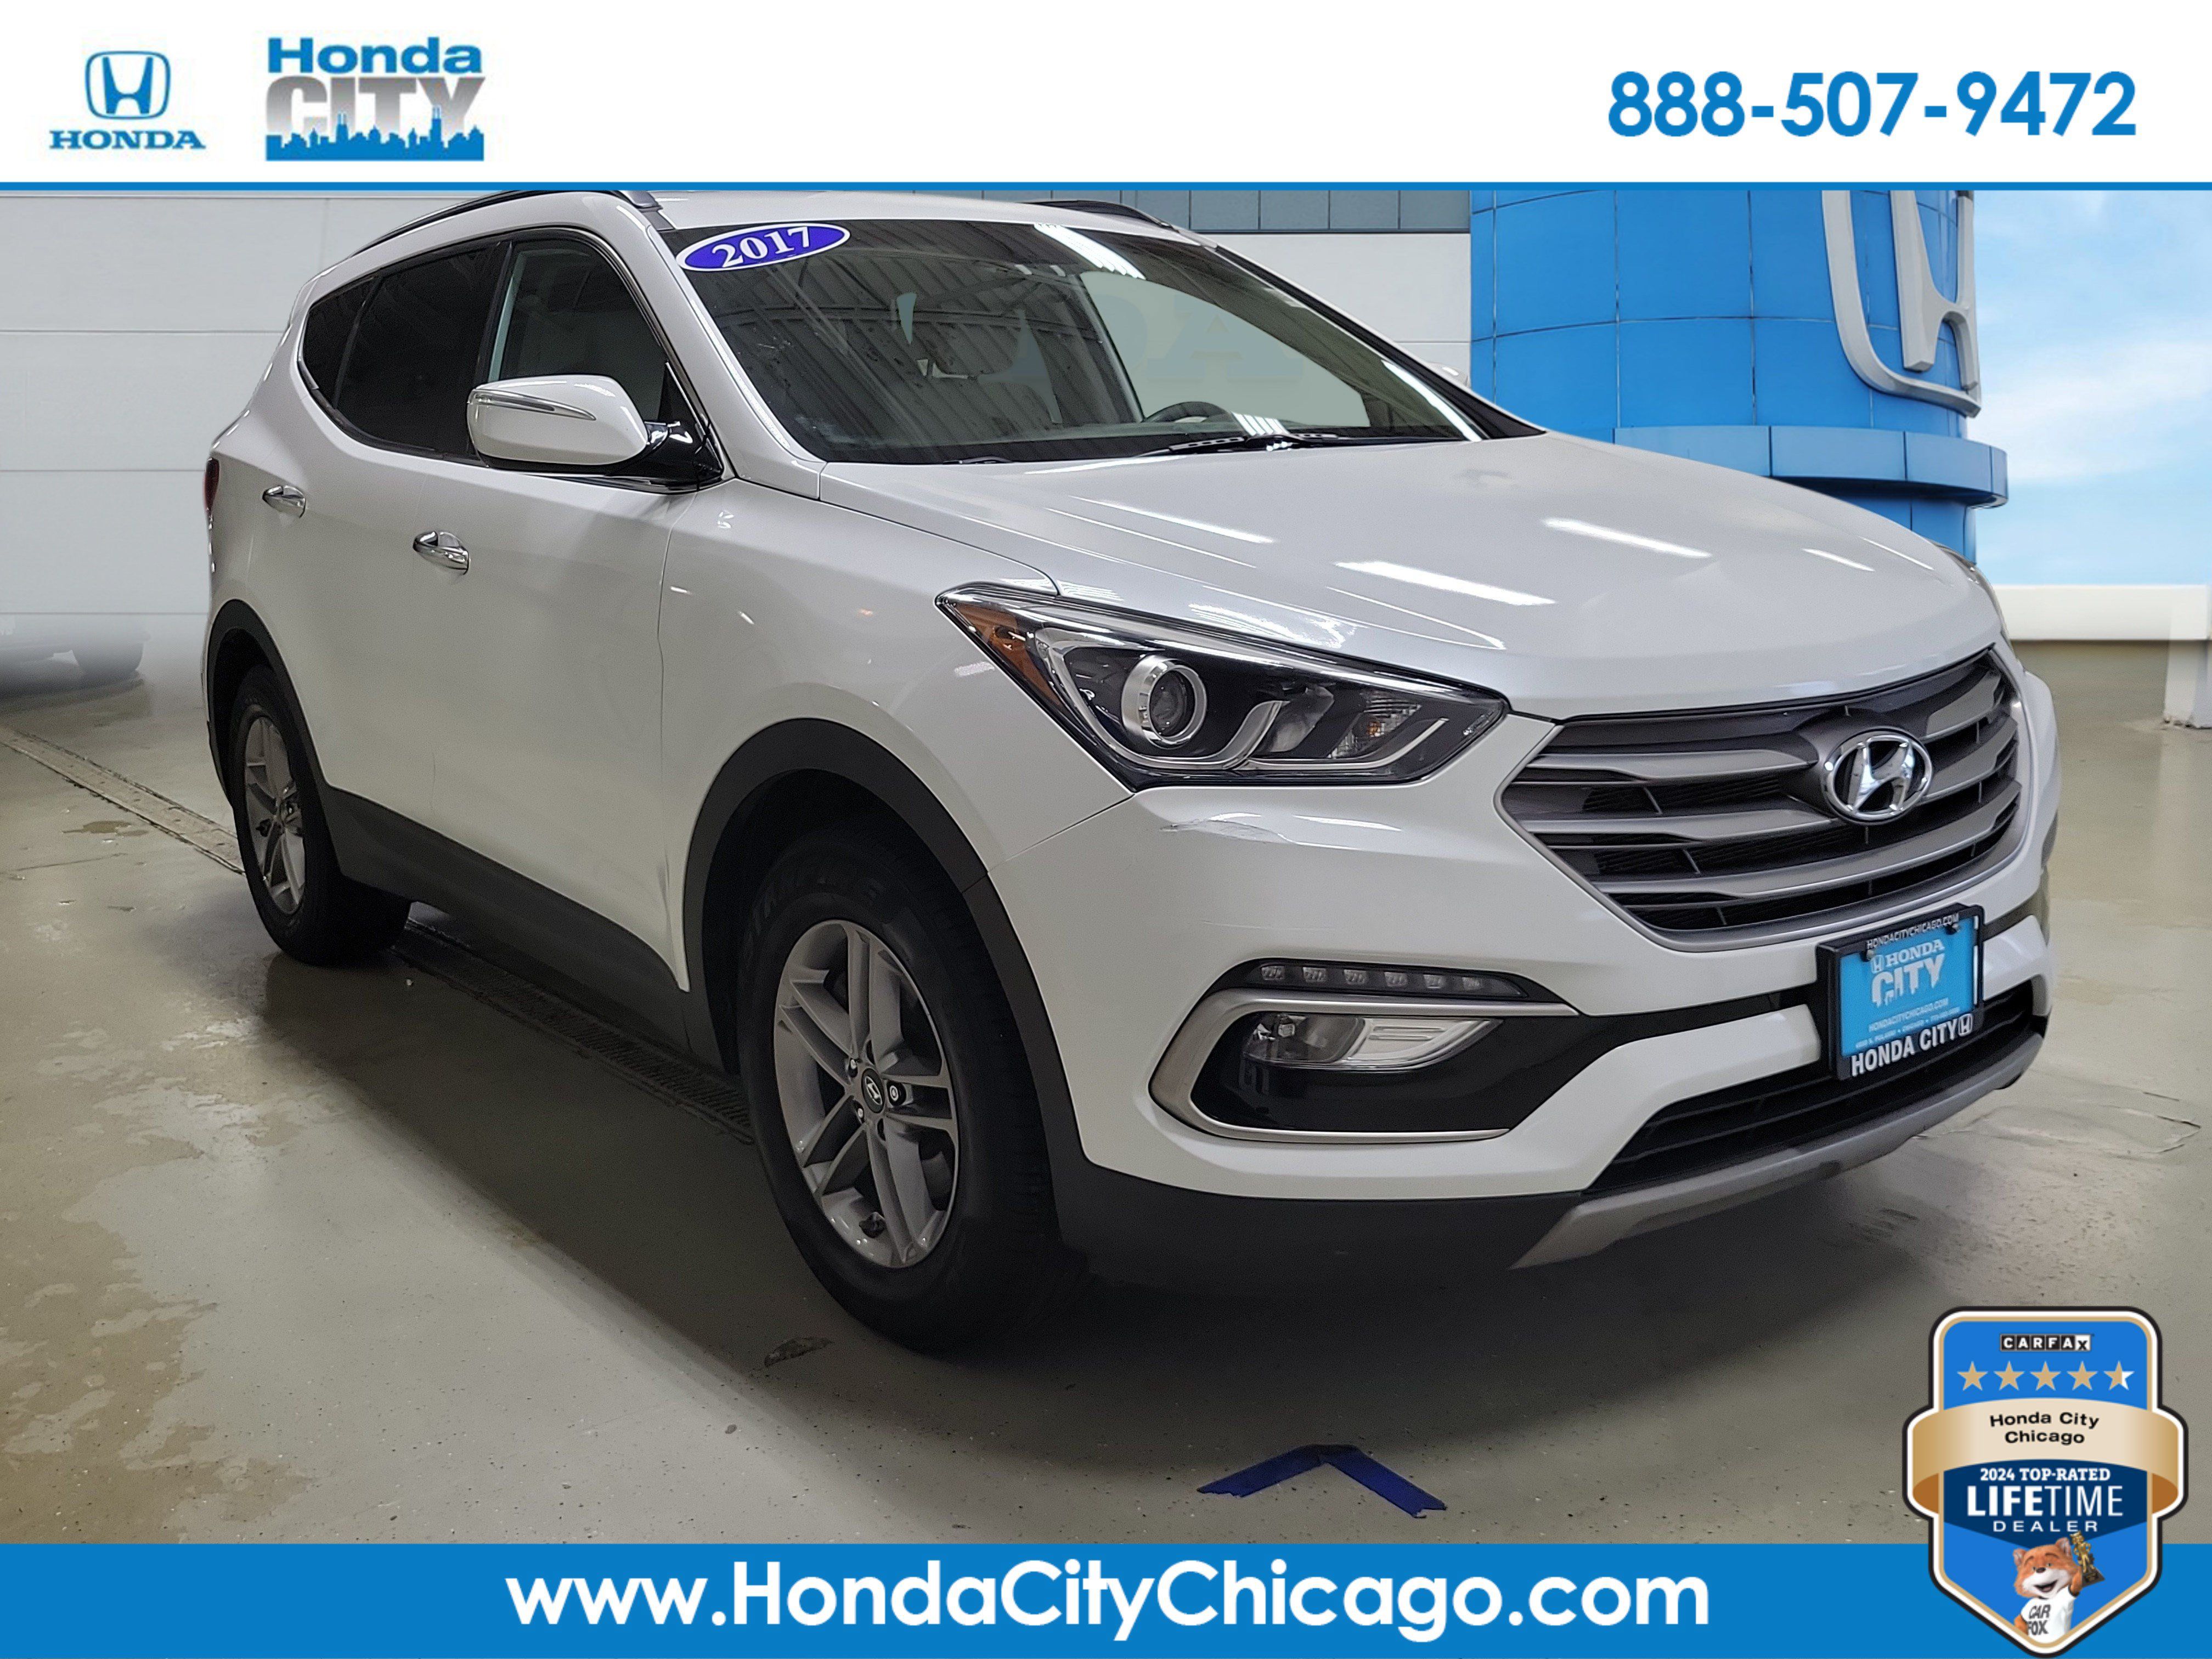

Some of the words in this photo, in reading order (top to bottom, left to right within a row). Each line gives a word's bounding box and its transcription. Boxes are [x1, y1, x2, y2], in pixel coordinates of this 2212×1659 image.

[713, 226, 809, 268] 2017
[1884, 939, 1945, 967] HONDA
[1871, 953, 1945, 1008] CITY
[1851, 1035, 1916, 1077] HONDA
[1920, 1019, 1959, 1051] CITY
